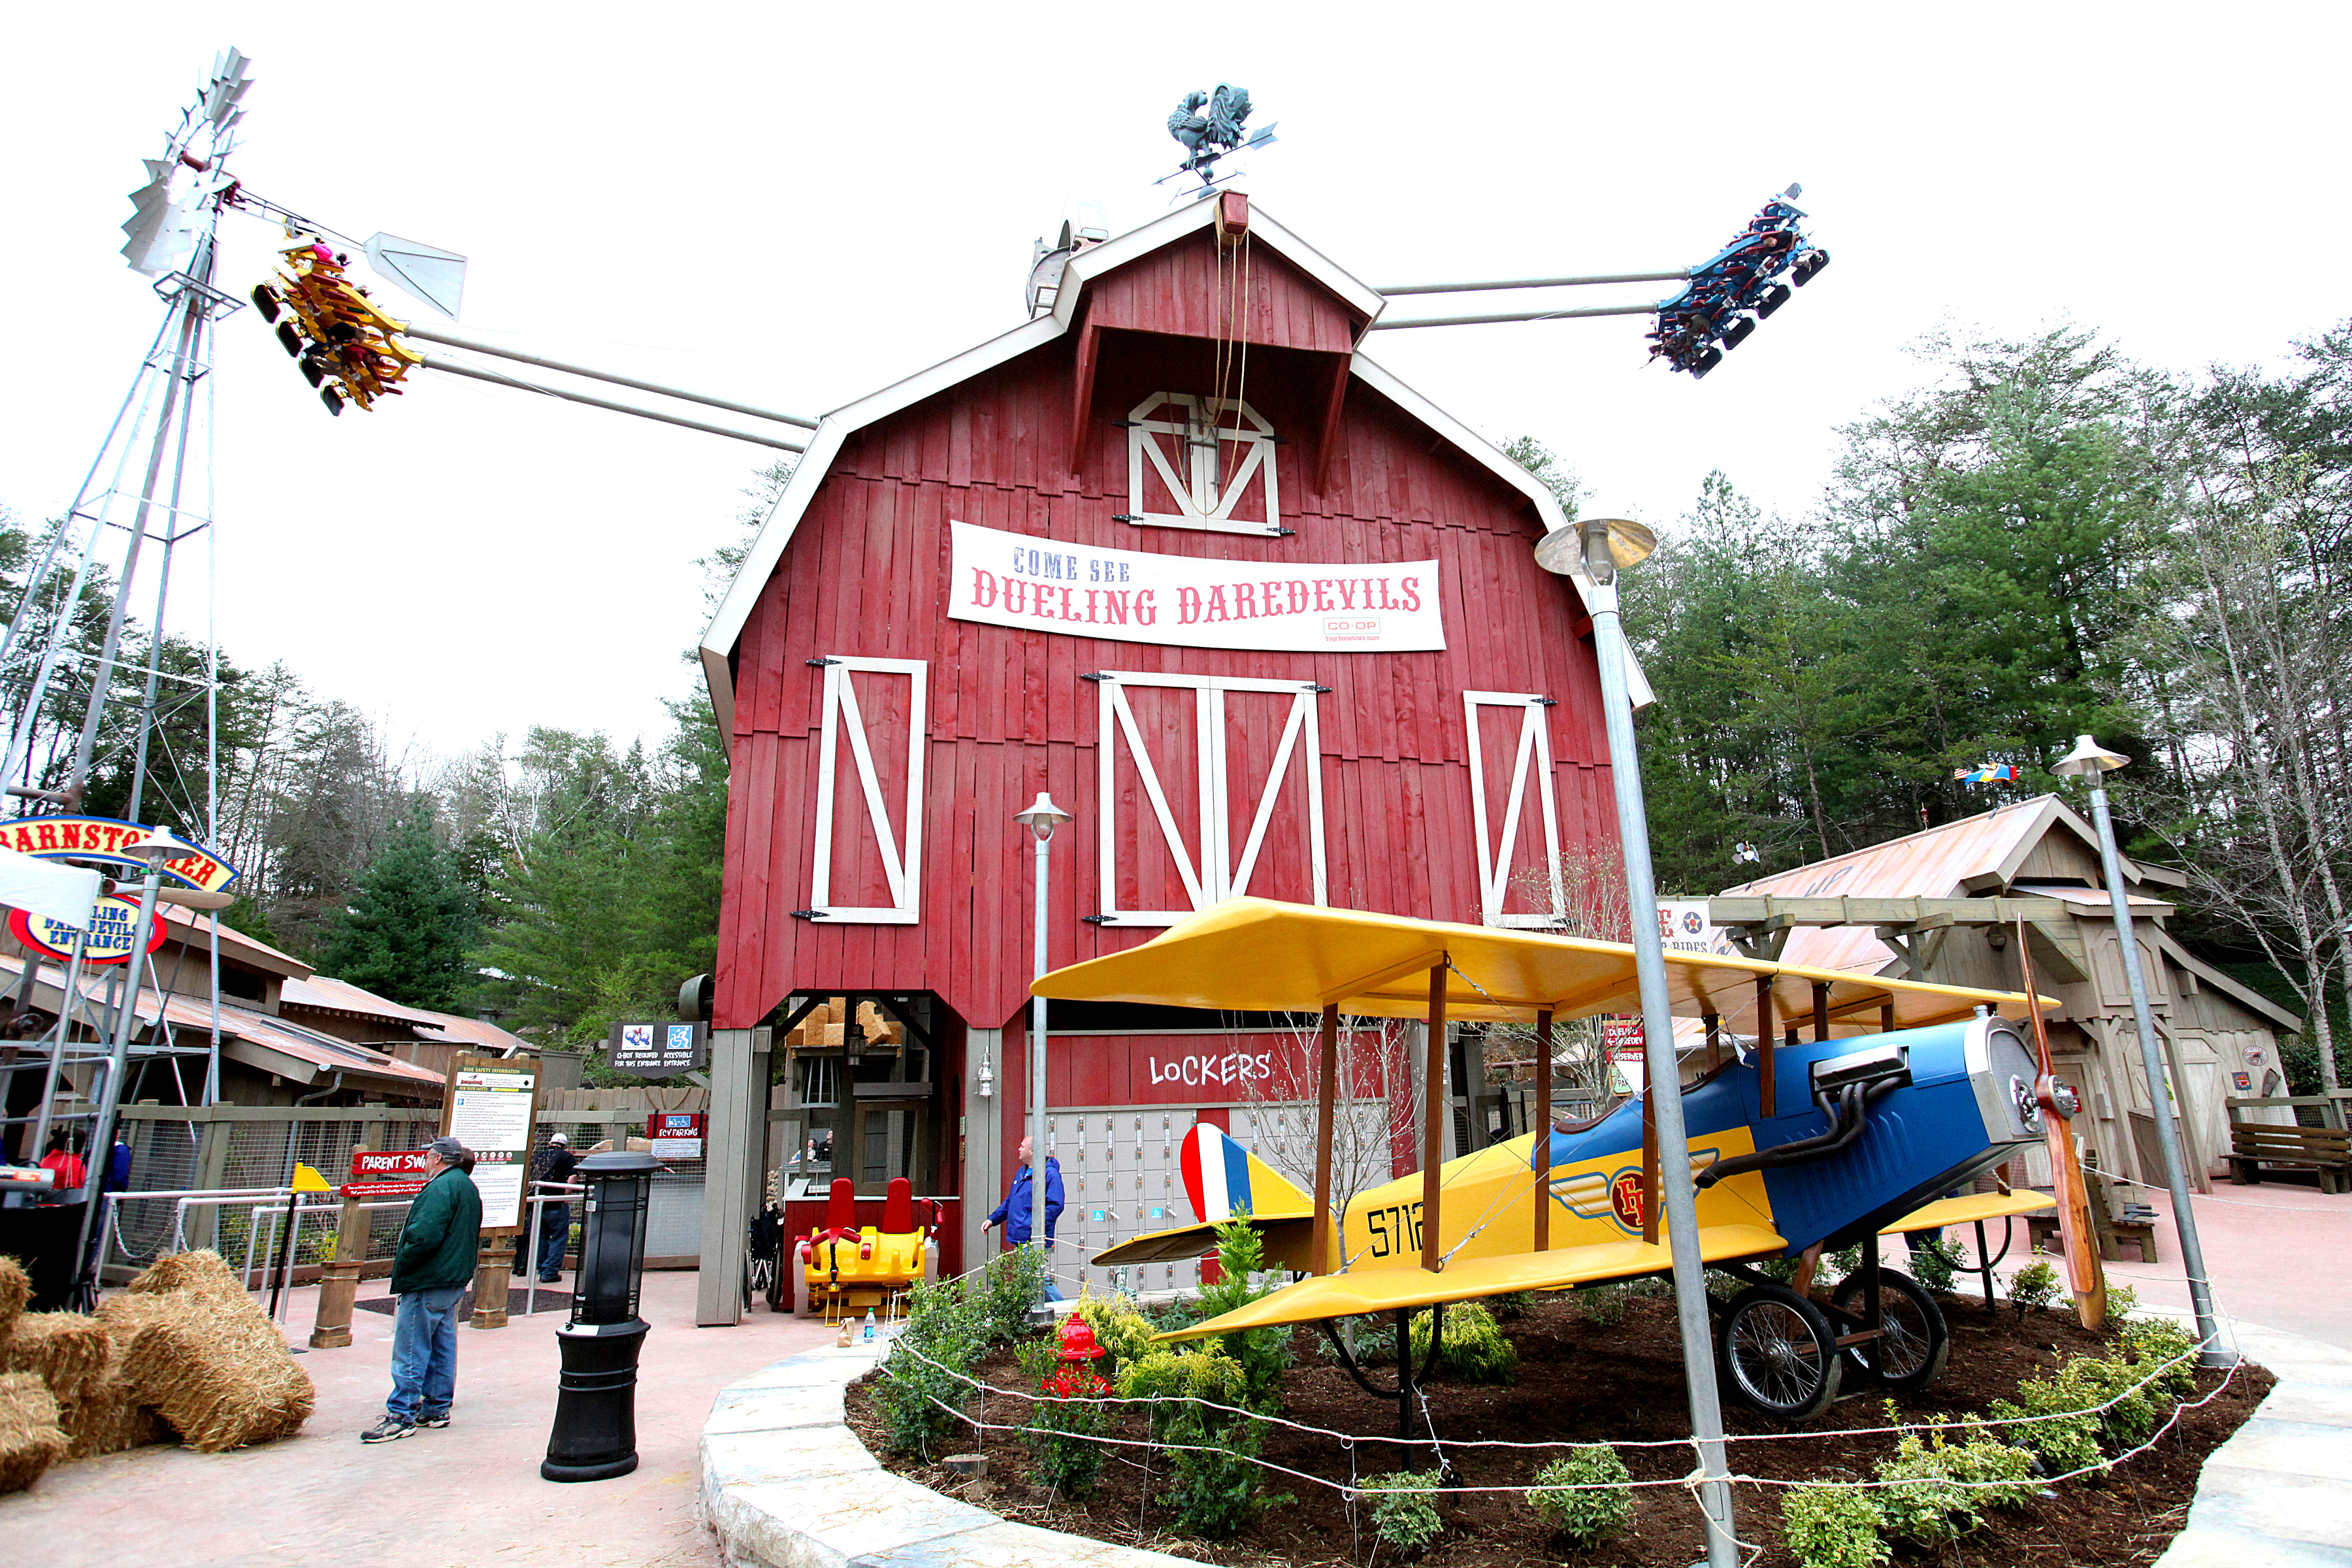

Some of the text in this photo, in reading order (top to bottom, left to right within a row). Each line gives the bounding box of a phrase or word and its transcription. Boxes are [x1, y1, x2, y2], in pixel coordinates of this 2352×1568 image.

[1013, 546, 1130, 582] COME SEE
[971, 566, 1421, 626] DUELING DAREDEVILS
[1328, 621, 1376, 630] CO-OP
[92, 906, 129, 921] LING
[663, 1051, 694, 1059] ACCESSIBLE
[659, 1127, 698, 1137] ECV PARKING
[361, 1155, 403, 1170] PARENT
